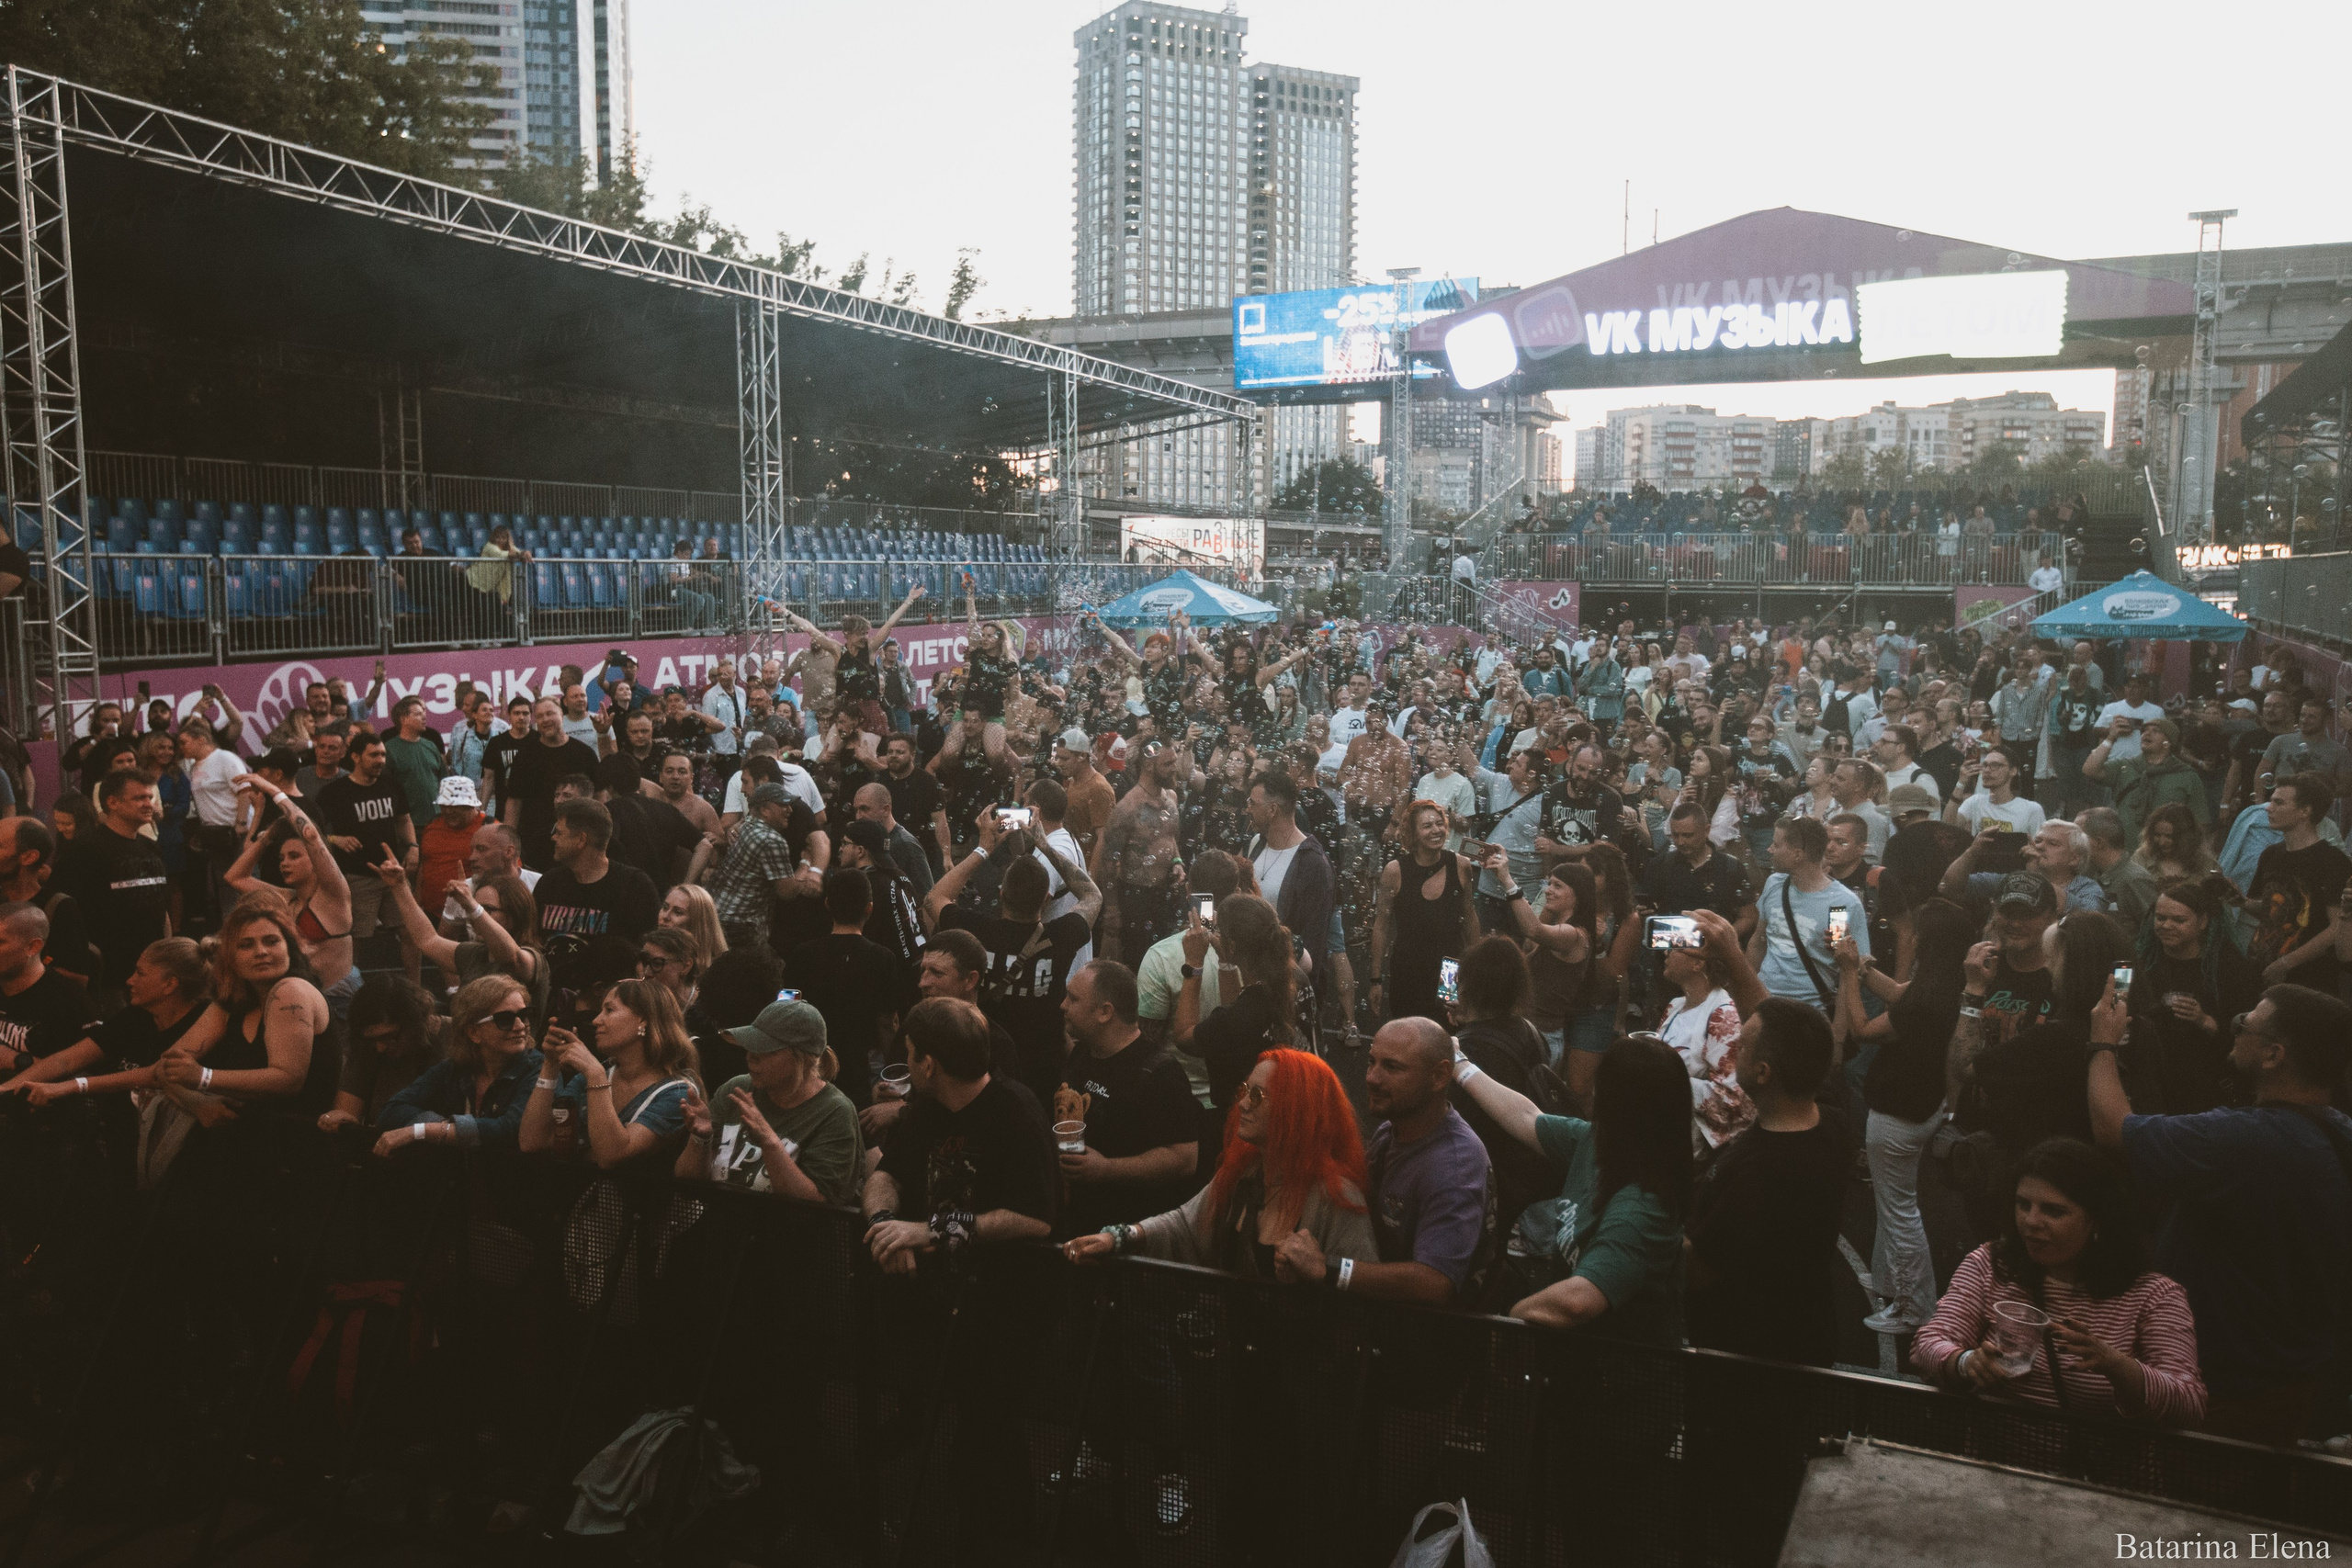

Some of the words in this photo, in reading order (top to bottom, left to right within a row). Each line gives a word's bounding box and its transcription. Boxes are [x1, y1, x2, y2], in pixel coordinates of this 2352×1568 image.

[1585, 312, 1642, 355] VK
[1649, 299, 1853, 353] МУЗЫКА
[354, 797, 394, 822] VOLK
[542, 904, 609, 935] NIRVANA
